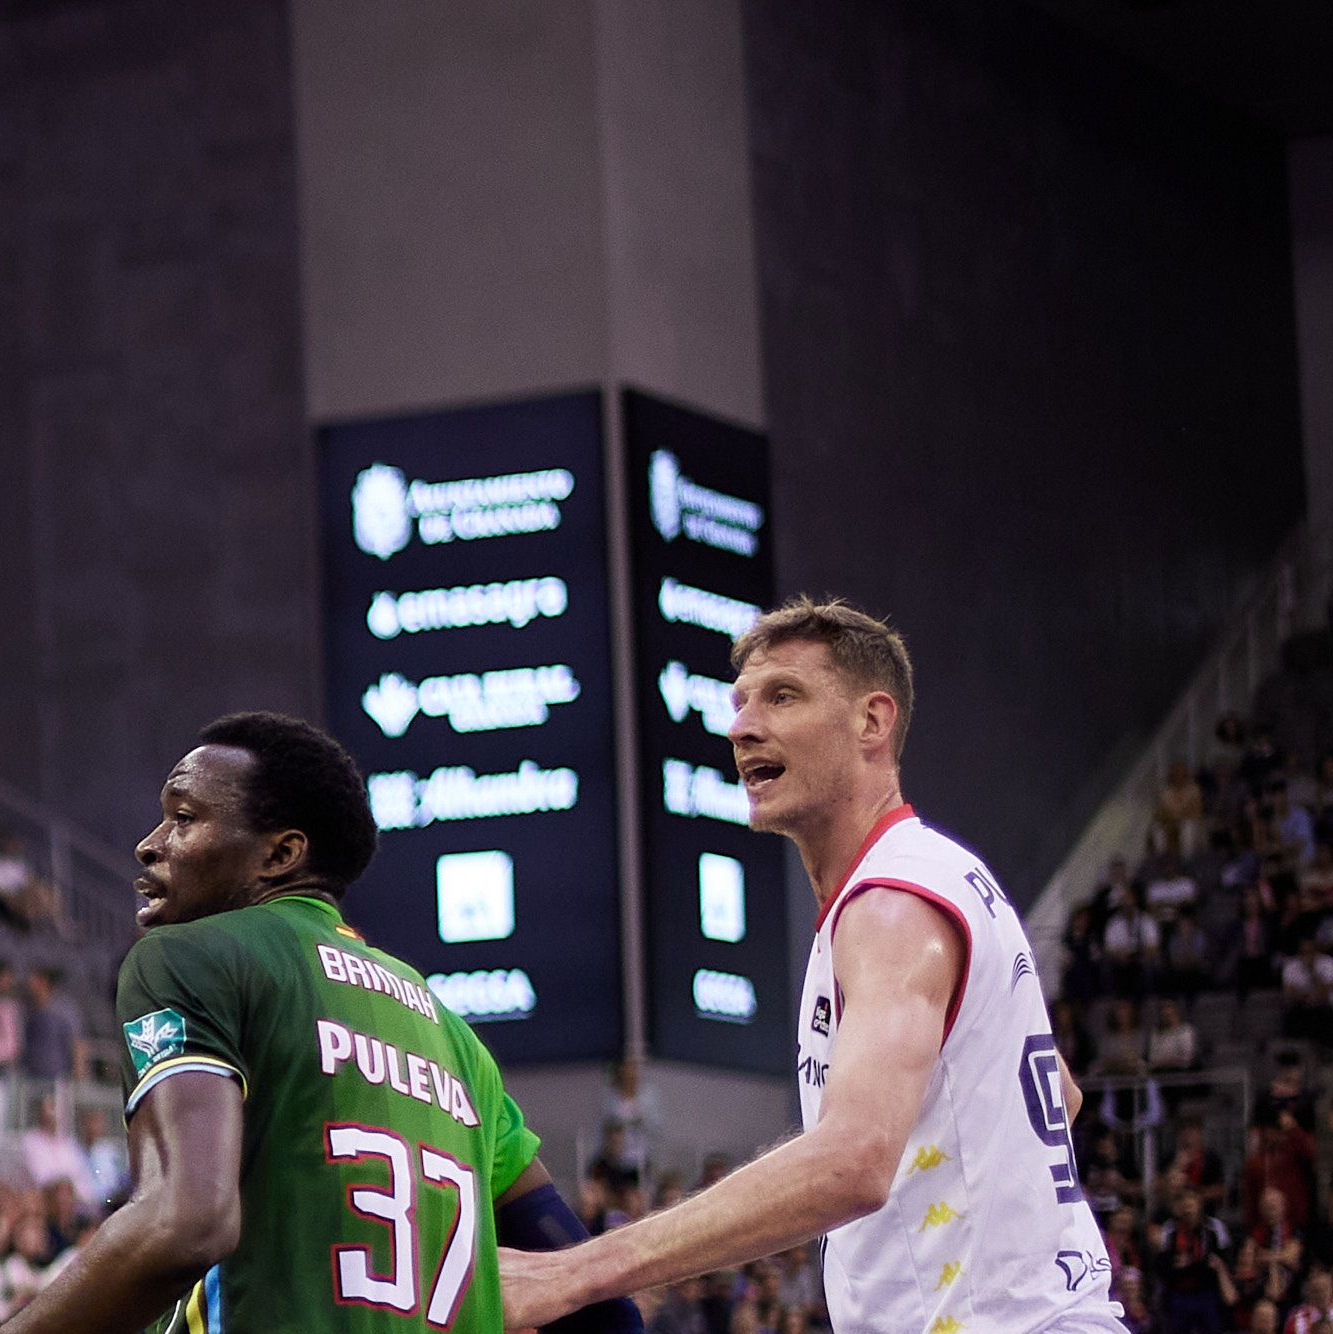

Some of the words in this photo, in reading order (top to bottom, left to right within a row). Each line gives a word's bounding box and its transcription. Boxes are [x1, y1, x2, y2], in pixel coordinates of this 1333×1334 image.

[317, 944, 439, 1025] BRIMAH
[316, 1018, 481, 1128] PULEVA
[325, 1122, 476, 1331] 37
